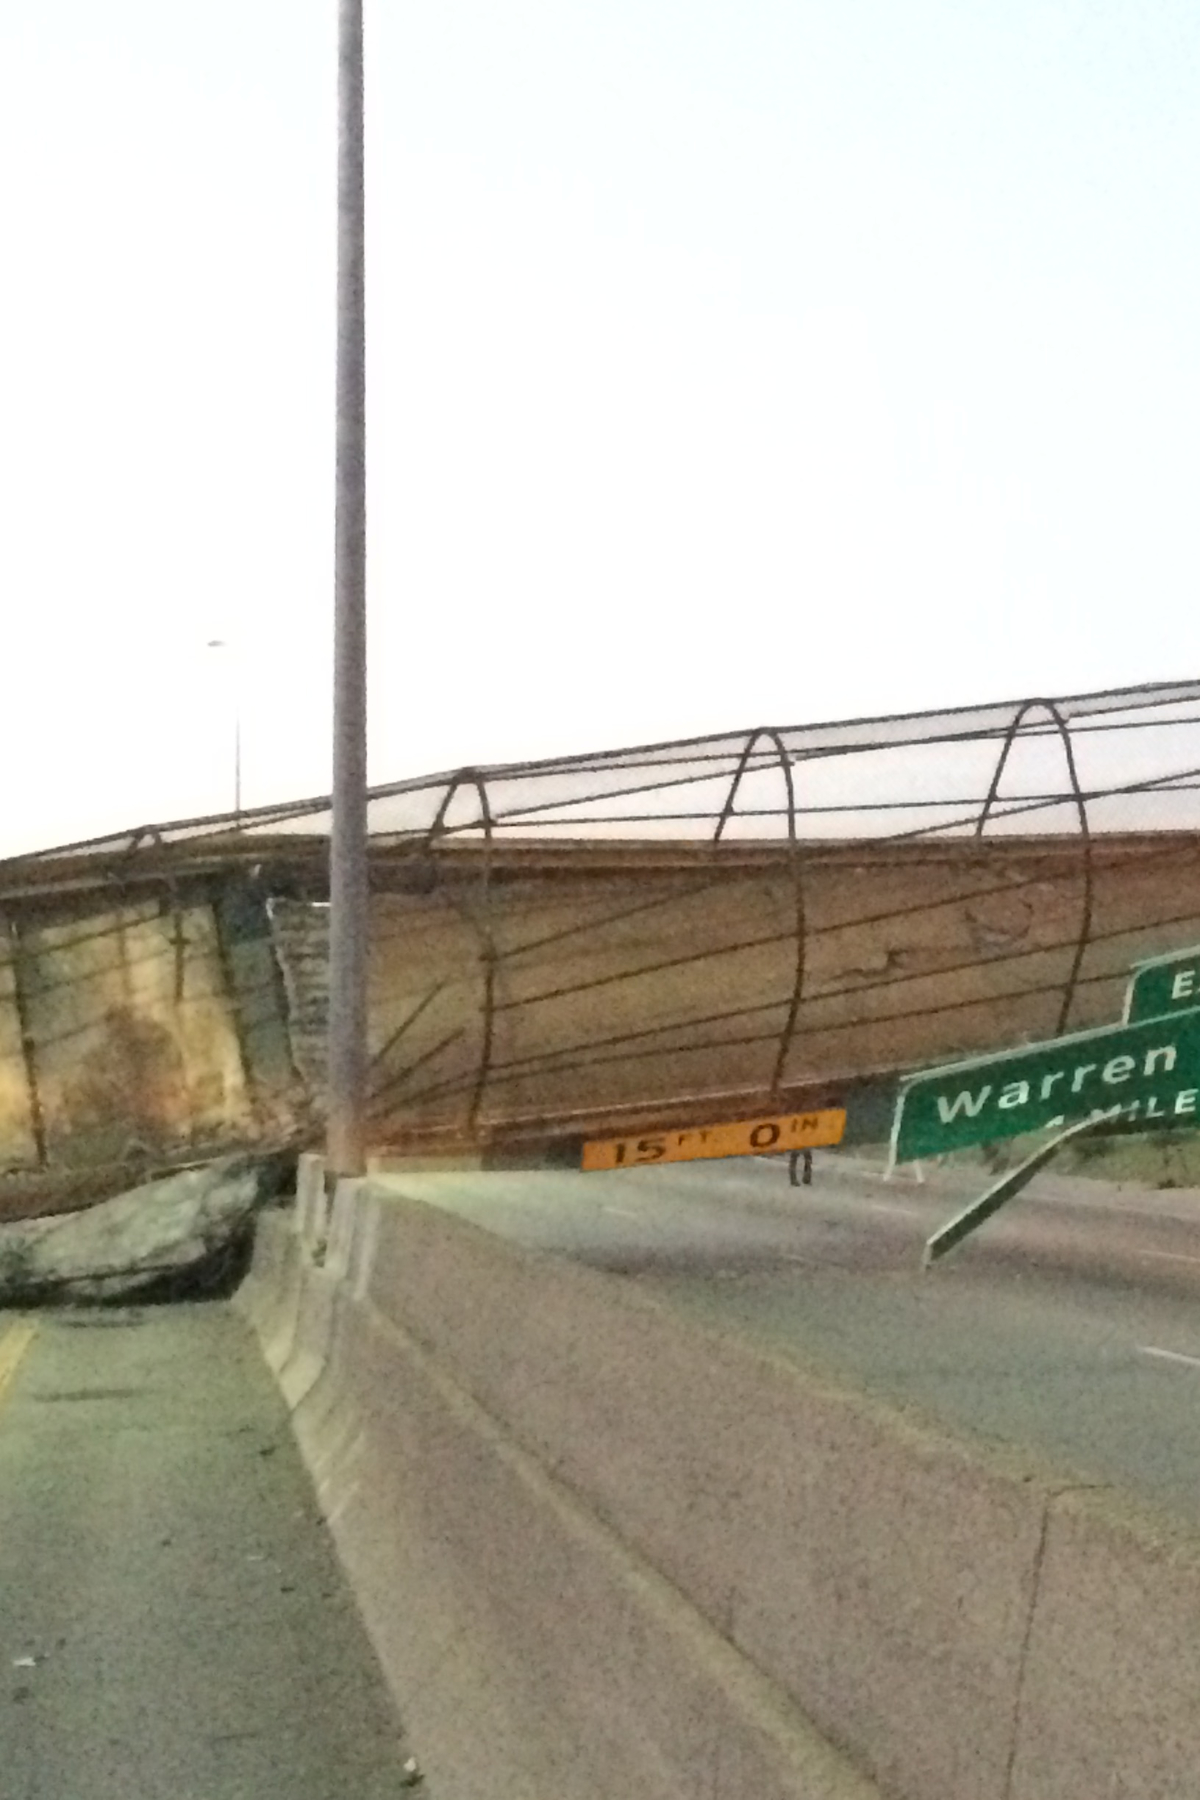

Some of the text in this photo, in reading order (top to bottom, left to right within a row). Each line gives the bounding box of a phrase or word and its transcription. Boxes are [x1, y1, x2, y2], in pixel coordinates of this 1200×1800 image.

[935, 1042, 1177, 1124] Warren
[615, 1117, 818, 1163] 15 FT 0 IN
